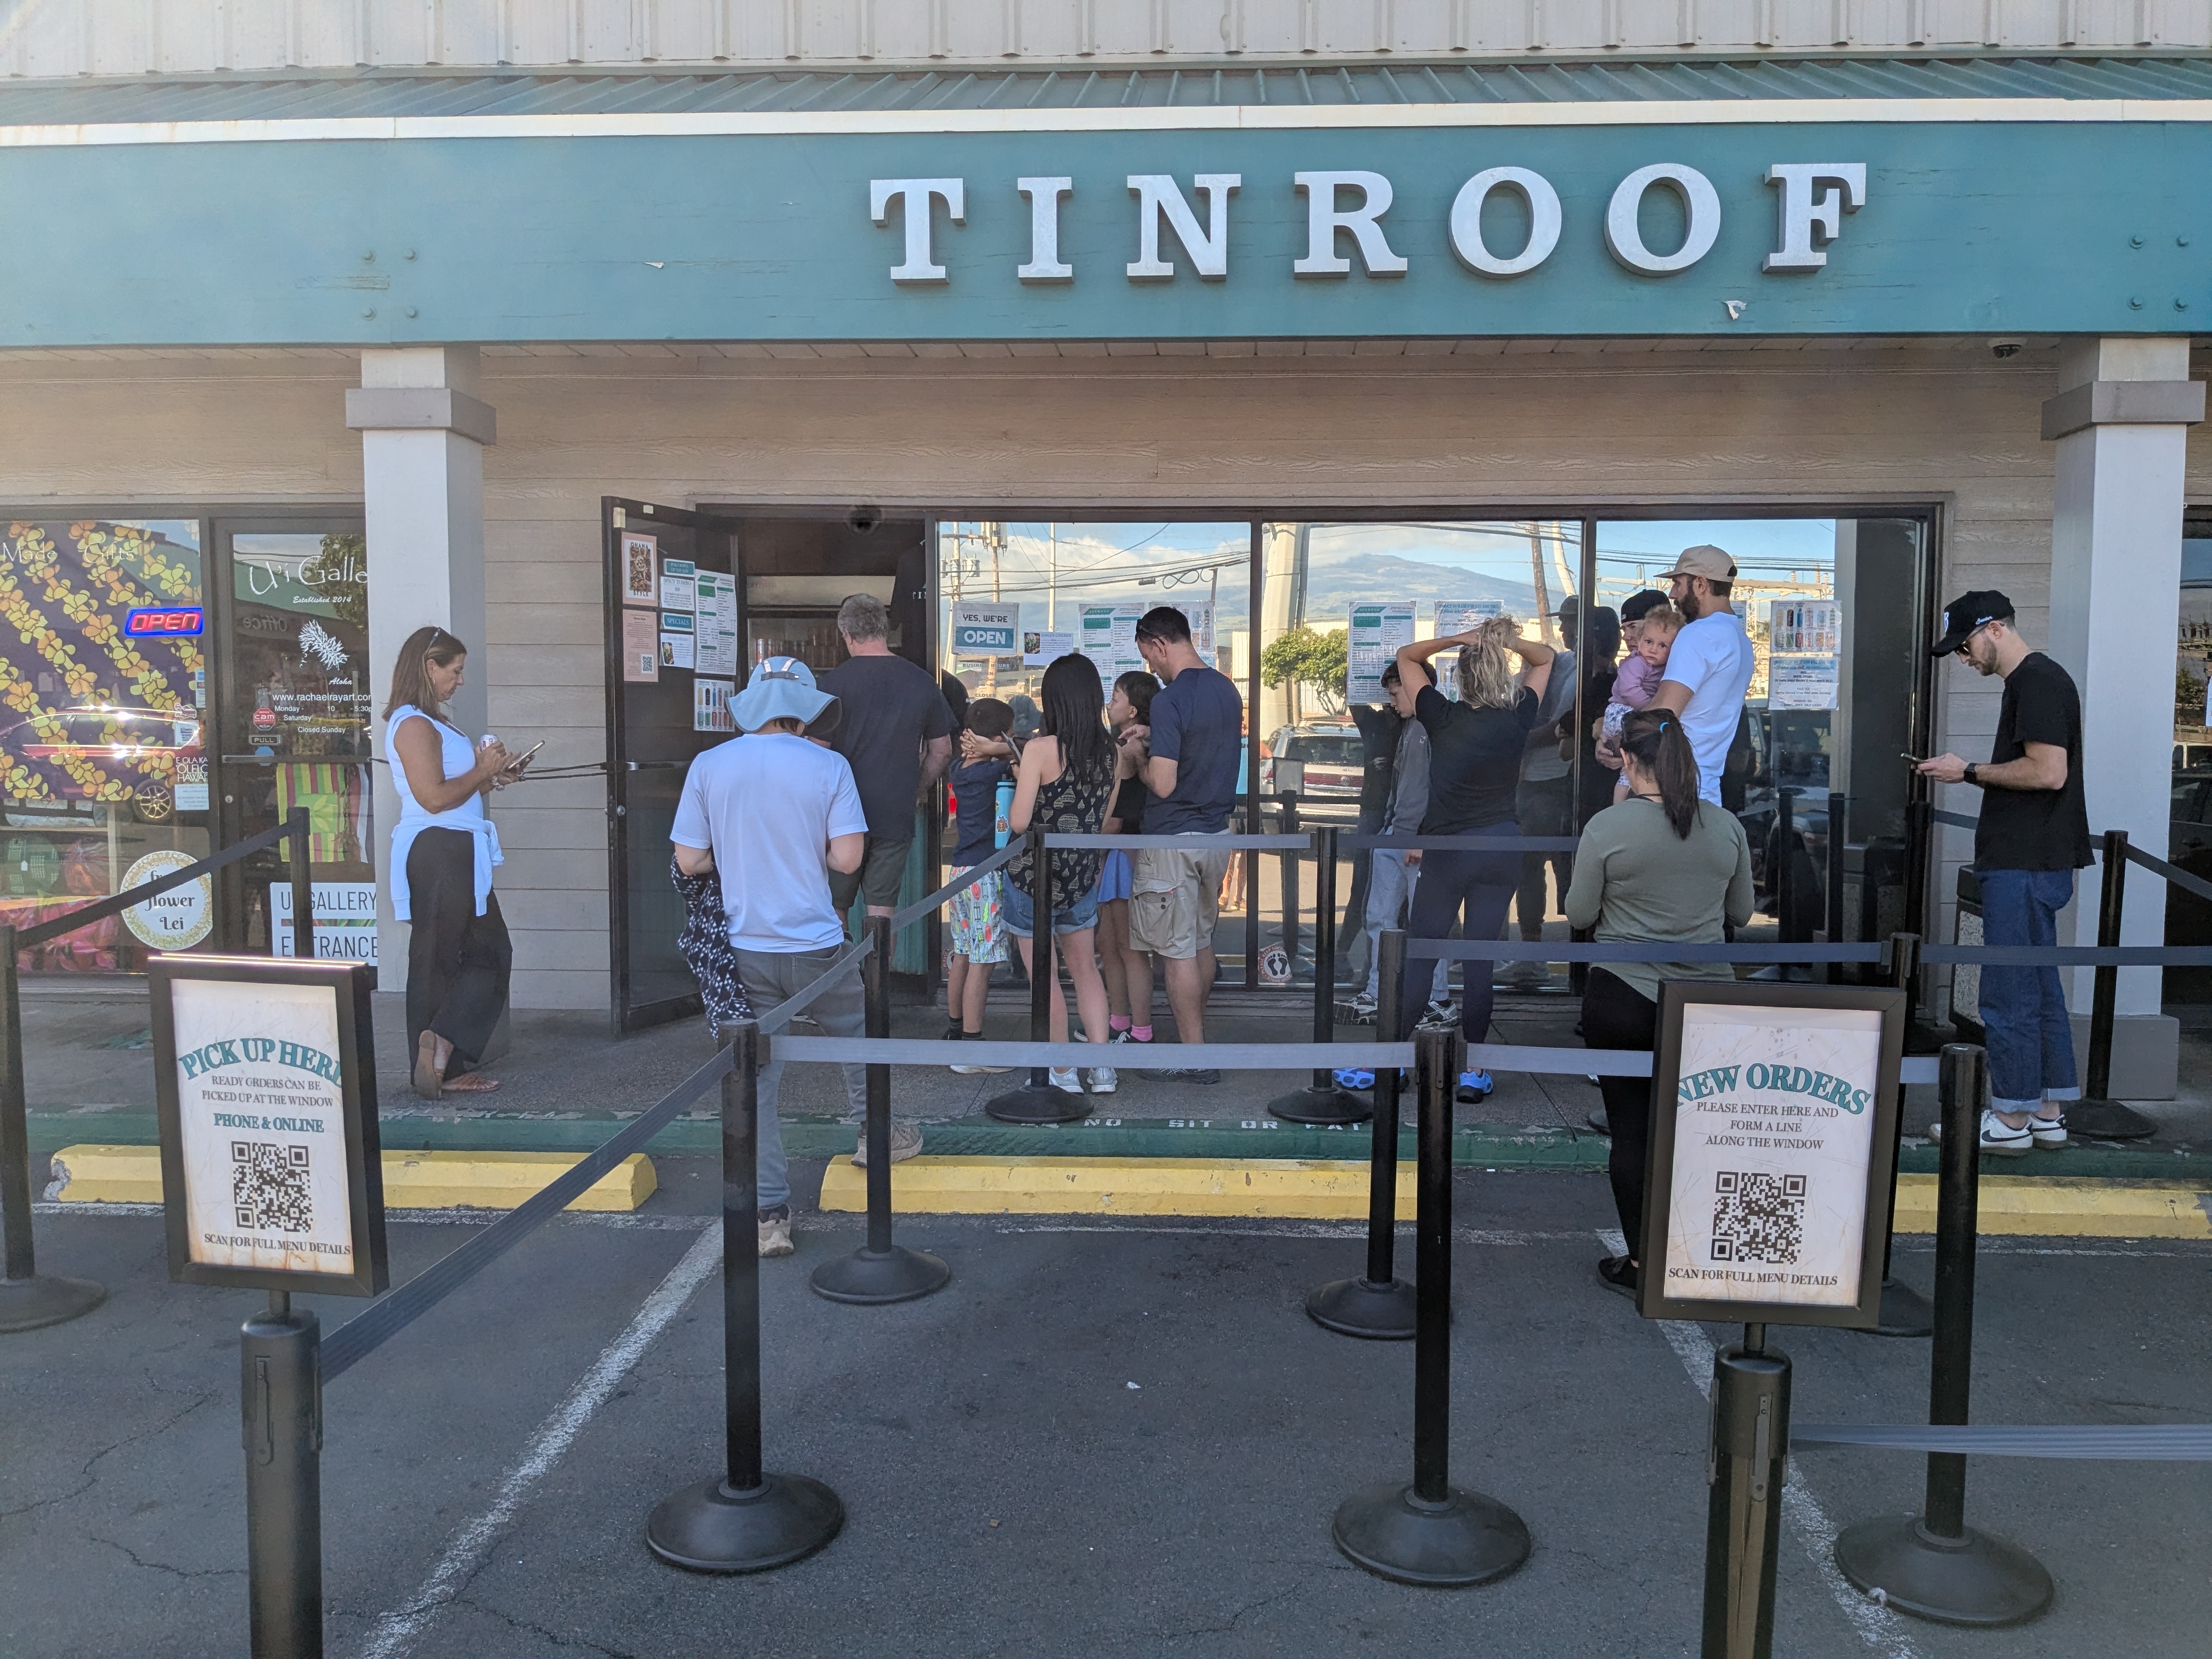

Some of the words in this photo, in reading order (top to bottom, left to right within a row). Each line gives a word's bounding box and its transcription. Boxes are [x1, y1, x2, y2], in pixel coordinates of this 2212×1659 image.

[870, 163, 1866, 285] TINROOF
[3, 541, 57, 563] Made
[83, 541, 135, 563] Gifts
[130, 613, 201, 631] OPEN
[667, 617, 689, 625] SPECIALS
[963, 614, 981, 623] YES,
[983, 614, 1008, 623] WE'RE
[964, 630, 1006, 645] OPEN
[329, 677, 353, 685] Aloha
[159, 916, 184, 930] Lei
[281, 936, 378, 958] ERANCE
[178, 1039, 241, 1080] PICK
[240, 1037, 276, 1063] UP
[212, 1075, 244, 1087] READY
[245, 1077, 284, 1089] ORDERS
[284, 1079, 305, 1090] CAN
[308, 1080, 321, 1091] BE
[1746, 1063, 1872, 1115] ORDERS
[201, 1090, 237, 1102] PICKED
[238, 1093, 252, 1103] UP
[253, 1094, 267, 1103] AT
[267, 1094, 287, 1105] THE
[289, 1096, 334, 1107] WINDOW
[1696, 1102, 1738, 1113] PLEASE
[1740, 1104, 1779, 1115] ENTER
[1781, 1106, 1811, 1116] HERE
[1812, 1107, 1839, 1118] AND
[213, 1113, 260, 1130] PHONE
[261, 1116, 272, 1130] &
[272, 1116, 325, 1133] ONLINE
[1169, 1119, 1214, 1128] SIT
[1241, 1120, 1278, 1129] OR
[1730, 1120, 1762, 1131] FORM
[1765, 1122, 1774, 1132] A
[1775, 1122, 1802, 1132] LINE
[1705, 1135, 1745, 1147] ALONG
[1747, 1137, 1771, 1147] THE
[1773, 1138, 1825, 1149] WINDOW
[205, 1233, 228, 1245] SCAN
[229, 1236, 251, 1247] FOR
[252, 1238, 276, 1249] FULL
[277, 1240, 307, 1251] MENU
[309, 1242, 351, 1255] DETAILS
[1668, 1268, 1700, 1279] SCAN
[1701, 1269, 1725, 1280] FOR
[1725, 1270, 1756, 1283] FULL
[1756, 1272, 1789, 1283] MENU
[1790, 1274, 1838, 1285] DETAILS
